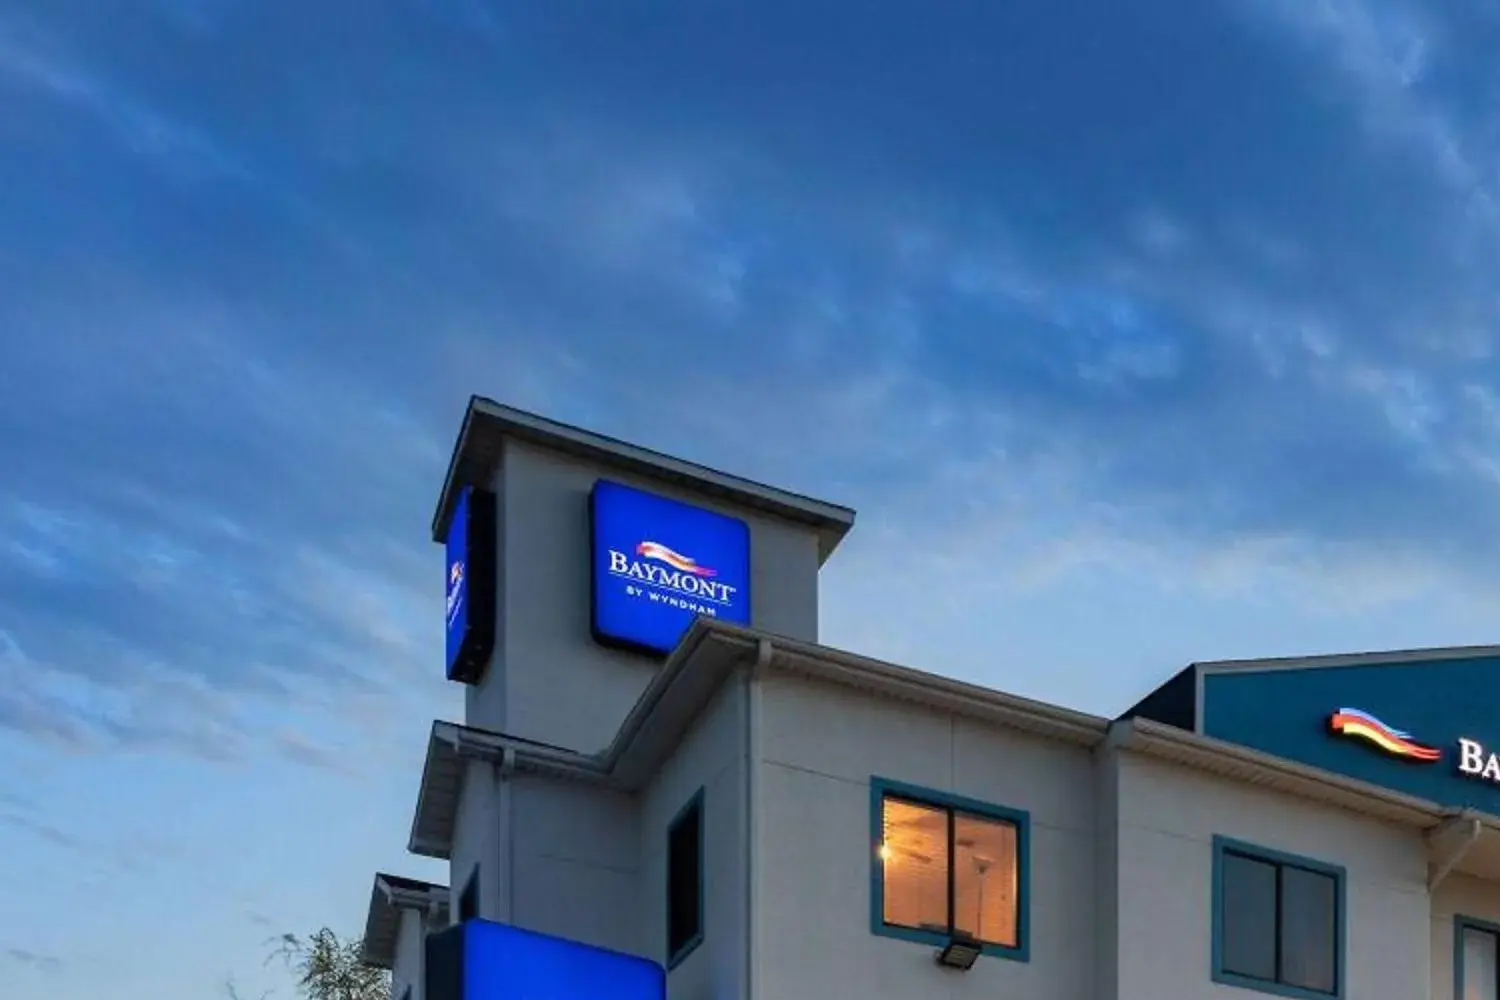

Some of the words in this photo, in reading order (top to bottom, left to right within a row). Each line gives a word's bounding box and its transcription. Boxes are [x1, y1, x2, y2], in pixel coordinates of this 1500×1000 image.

[608, 549, 733, 601] BAYMONT
[626, 584, 643, 597] BY
[648, 591, 717, 617] WYNDHAM
